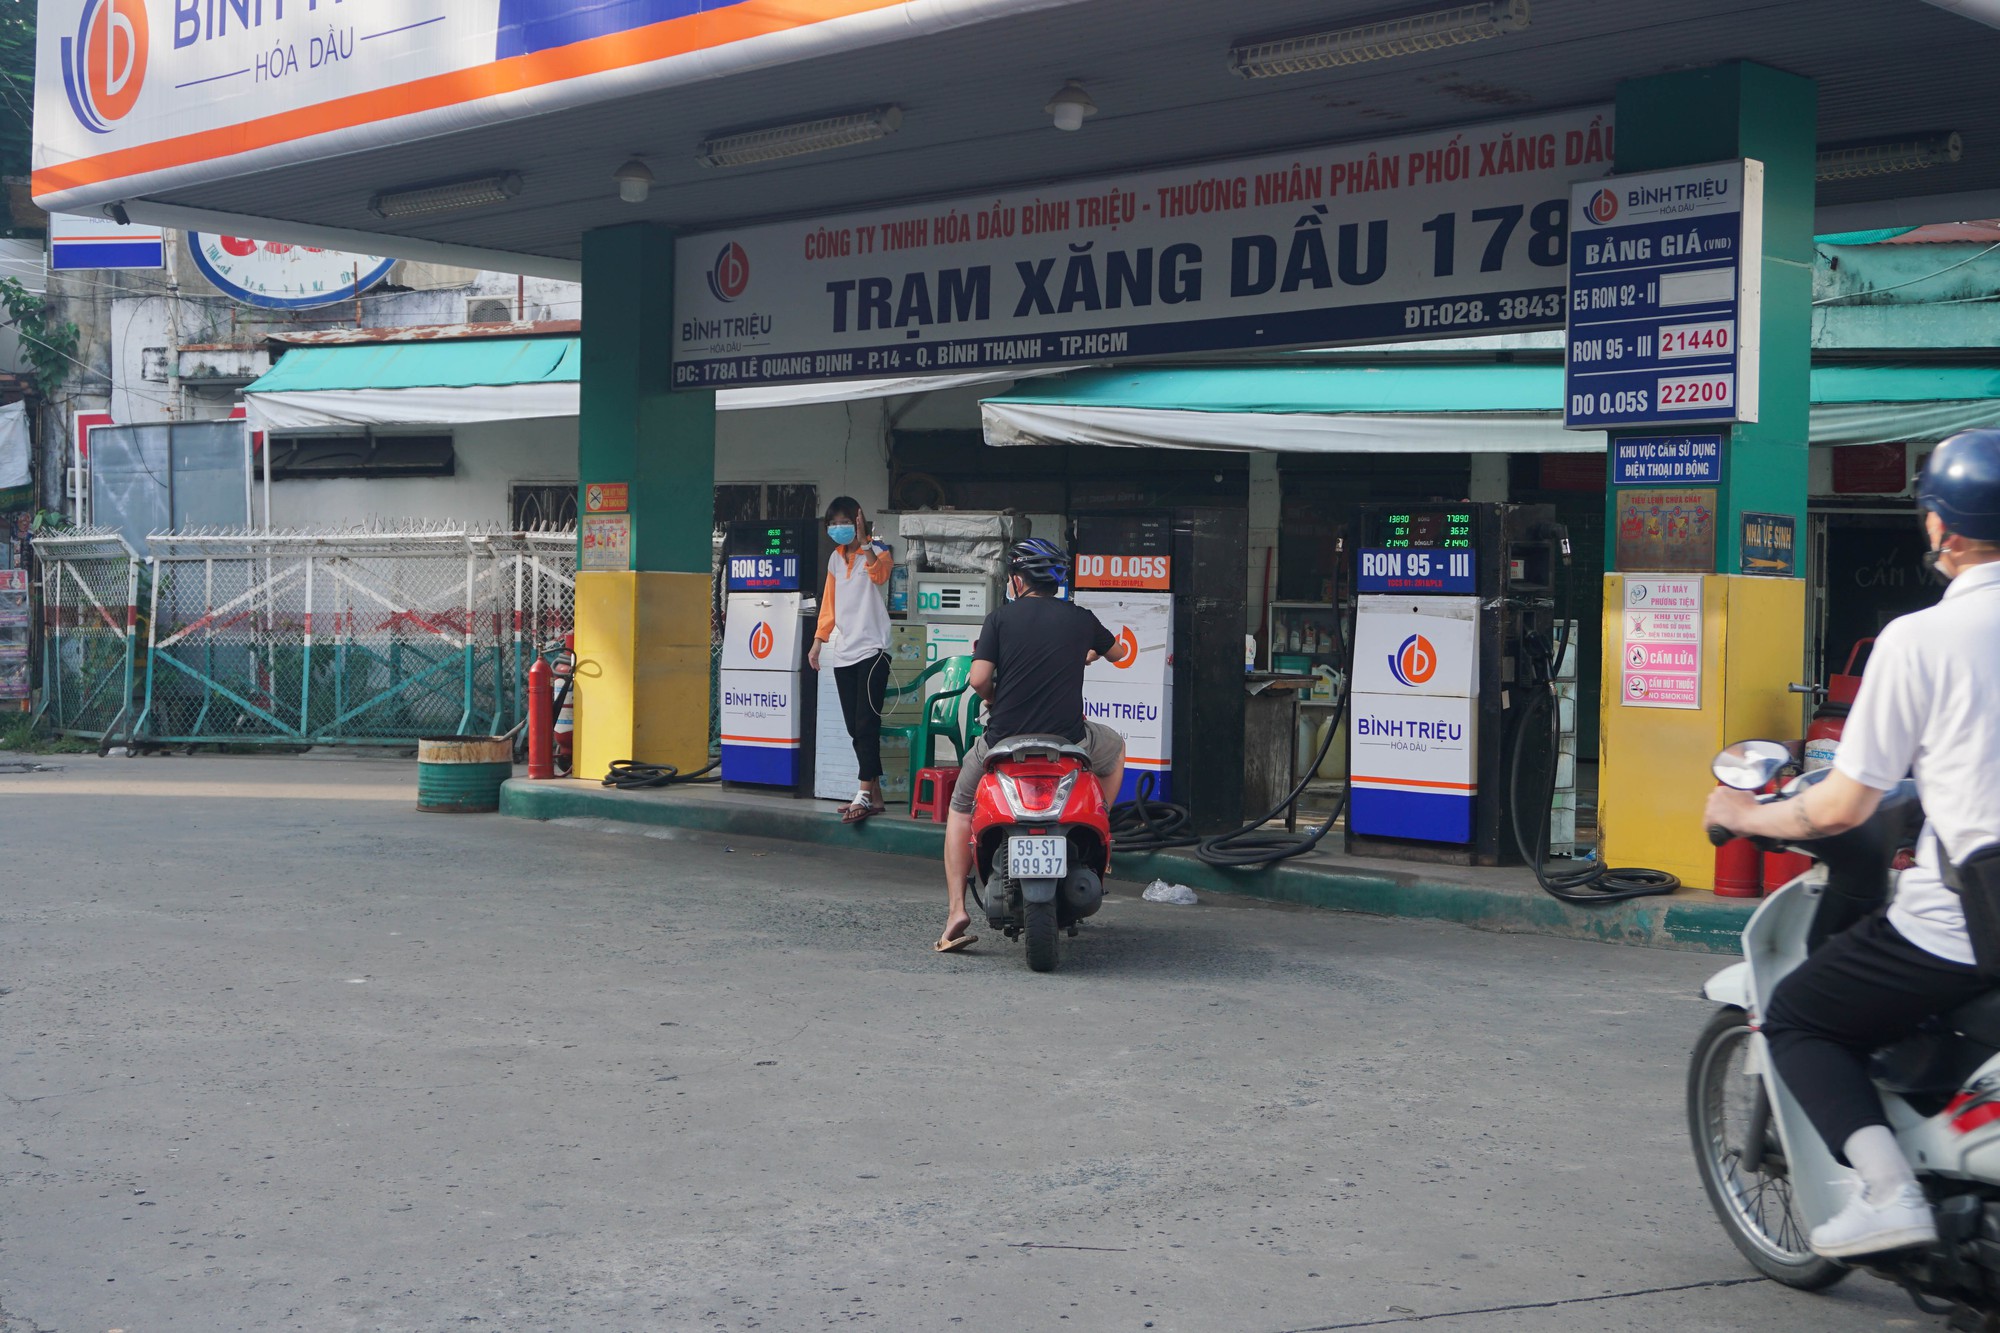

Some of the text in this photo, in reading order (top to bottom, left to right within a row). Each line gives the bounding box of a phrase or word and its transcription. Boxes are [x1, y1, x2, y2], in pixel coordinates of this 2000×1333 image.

[256, 24, 353, 83] HÓA DẦU
[805, 226, 850, 260] CÔNG
[856, 225, 876, 254] TY
[881, 218, 928, 251] TNHH
[934, 209, 971, 245] HÓA
[977, 199, 1015, 240] DẦU
[1022, 198, 1070, 235] BÌNH
[1076, 187, 1135, 231] TRIỆU
[1158, 176, 1247, 218] THƯƠNG
[1255, 162, 1322, 206] NHÂN
[1330, 152, 1399, 196] PHÂN
[1408, 134, 1470, 187] PHỐI
[1479, 132, 1555, 177] XĂNG
[1628, 178, 1728, 207] BÌNH TRIỆU
[1585, 228, 1731, 265] BẢNG GIÁ (VND)
[826, 265, 991, 339] TRẠM
[1013, 241, 1202, 317] XĂNG
[1230, 204, 1388, 298] DẦU
[1573, 289, 1588, 311] E5
[1591, 286, 1616, 309] RON
[1620, 284, 1635, 306] 92
[1647, 282, 1656, 304] II
[676, 366, 699, 383] ĐC:
[704, 362, 737, 381] 178A
[741, 357, 757, 378] LÊ
[762, 356, 811, 377] QUANG
[815, 353, 853, 376] ĐỊNH
[868, 350, 899, 369] P.14
[916, 347, 932, 366] Q.
[938, 342, 978, 364] BÌNH
[984, 339, 1041, 363] THẠNH
[1060, 332, 1127, 356] TP.HCM
[1498, 294, 1566, 320] 3843
[682, 313, 772, 341] BÌNH TRIỆU
[1573, 340, 1602, 362] RON
[1606, 338, 1623, 360] 95
[1637, 335, 1652, 357] III
[1662, 328, 1728, 352] 21440
[1572, 381, 1727, 416] DO 0.05S 22200
[1620, 439, 1716, 460] KHU VỰC CẤM SỬ DỤNG
[1625, 459, 1709, 479] ĐIỆN THOẠI DI ĐỘNG
[731, 559, 755, 578] RON
[758, 559, 772, 577] 95
[784, 558, 796, 577] III
[1078, 555, 1166, 578] DO 0.05S
[1363, 553, 1401, 576] RON
[1407, 553, 1430, 577] 95
[1450, 553, 1469, 577] III
[1650, 650, 1694, 665] CẤM LỬA
[725, 687, 786, 710] BÌNH TRIỆU
[1084, 697, 1157, 723] ÌNH TRIỆU
[1358, 714, 1461, 743] BÌNH TRIỆU
[1012, 858, 1062, 875] 899.37
